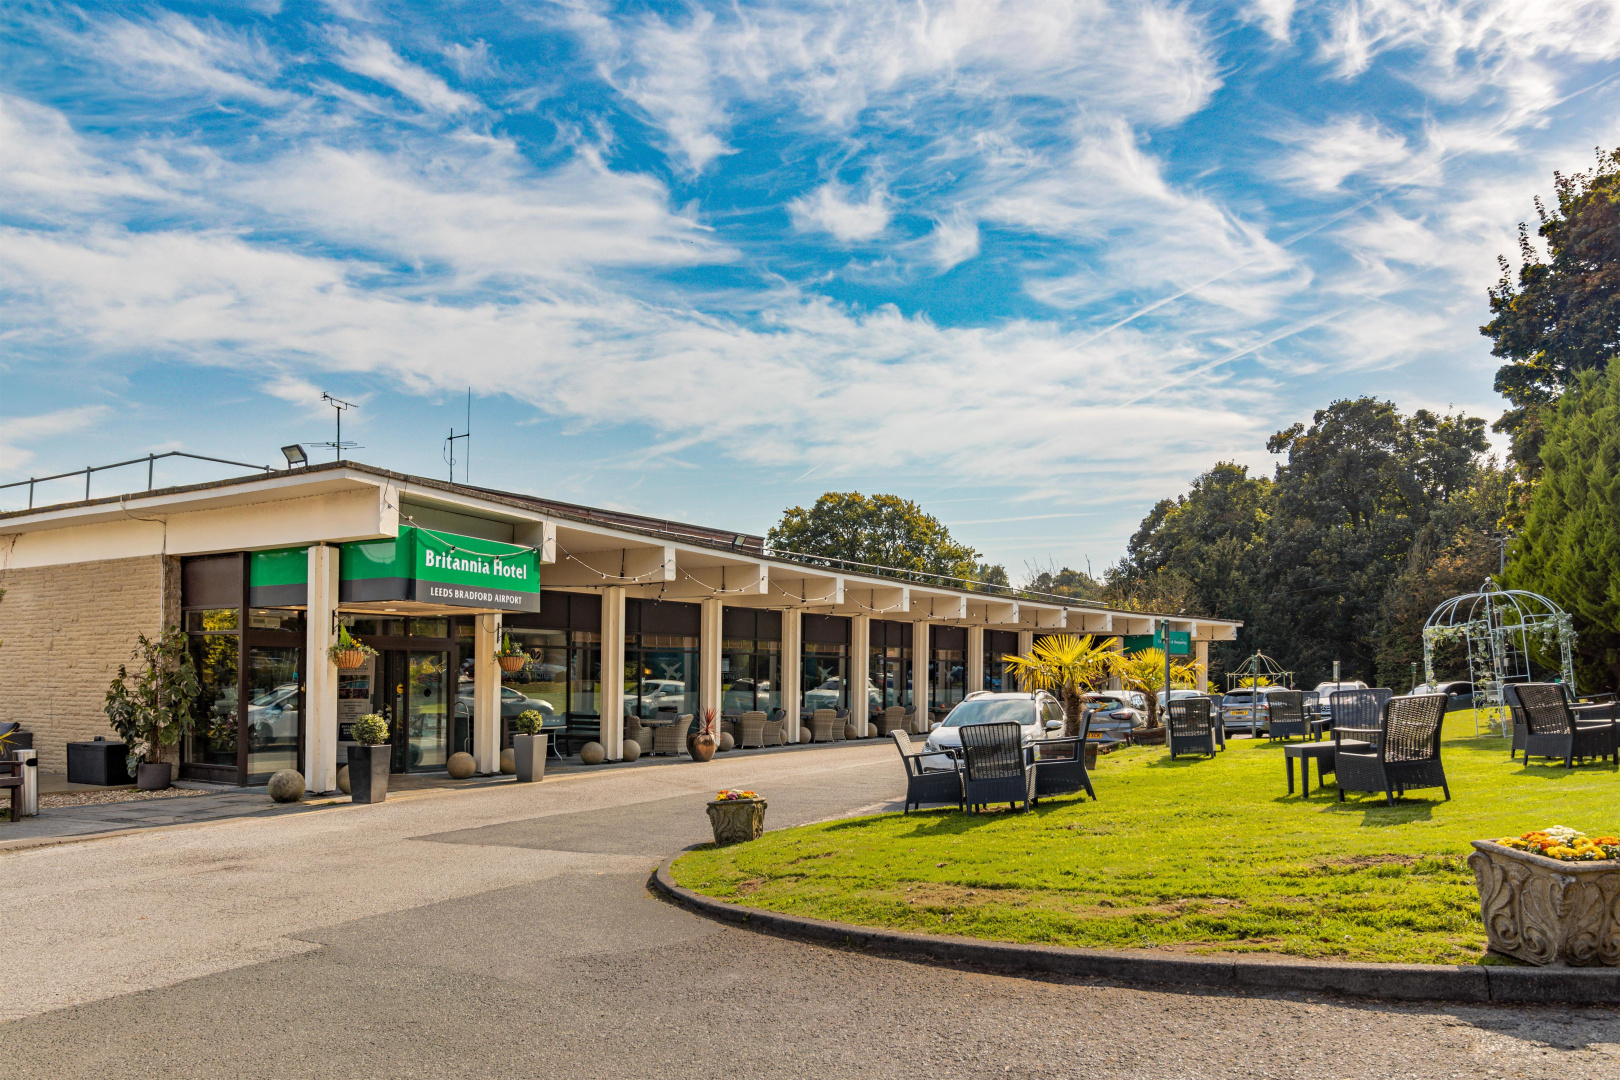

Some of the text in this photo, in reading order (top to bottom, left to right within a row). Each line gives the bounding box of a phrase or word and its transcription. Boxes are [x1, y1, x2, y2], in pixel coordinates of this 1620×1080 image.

[426, 549, 527, 579] Britannia Hotel
[431, 587, 522, 604] LEEDS BRADFORD AIRPORT
